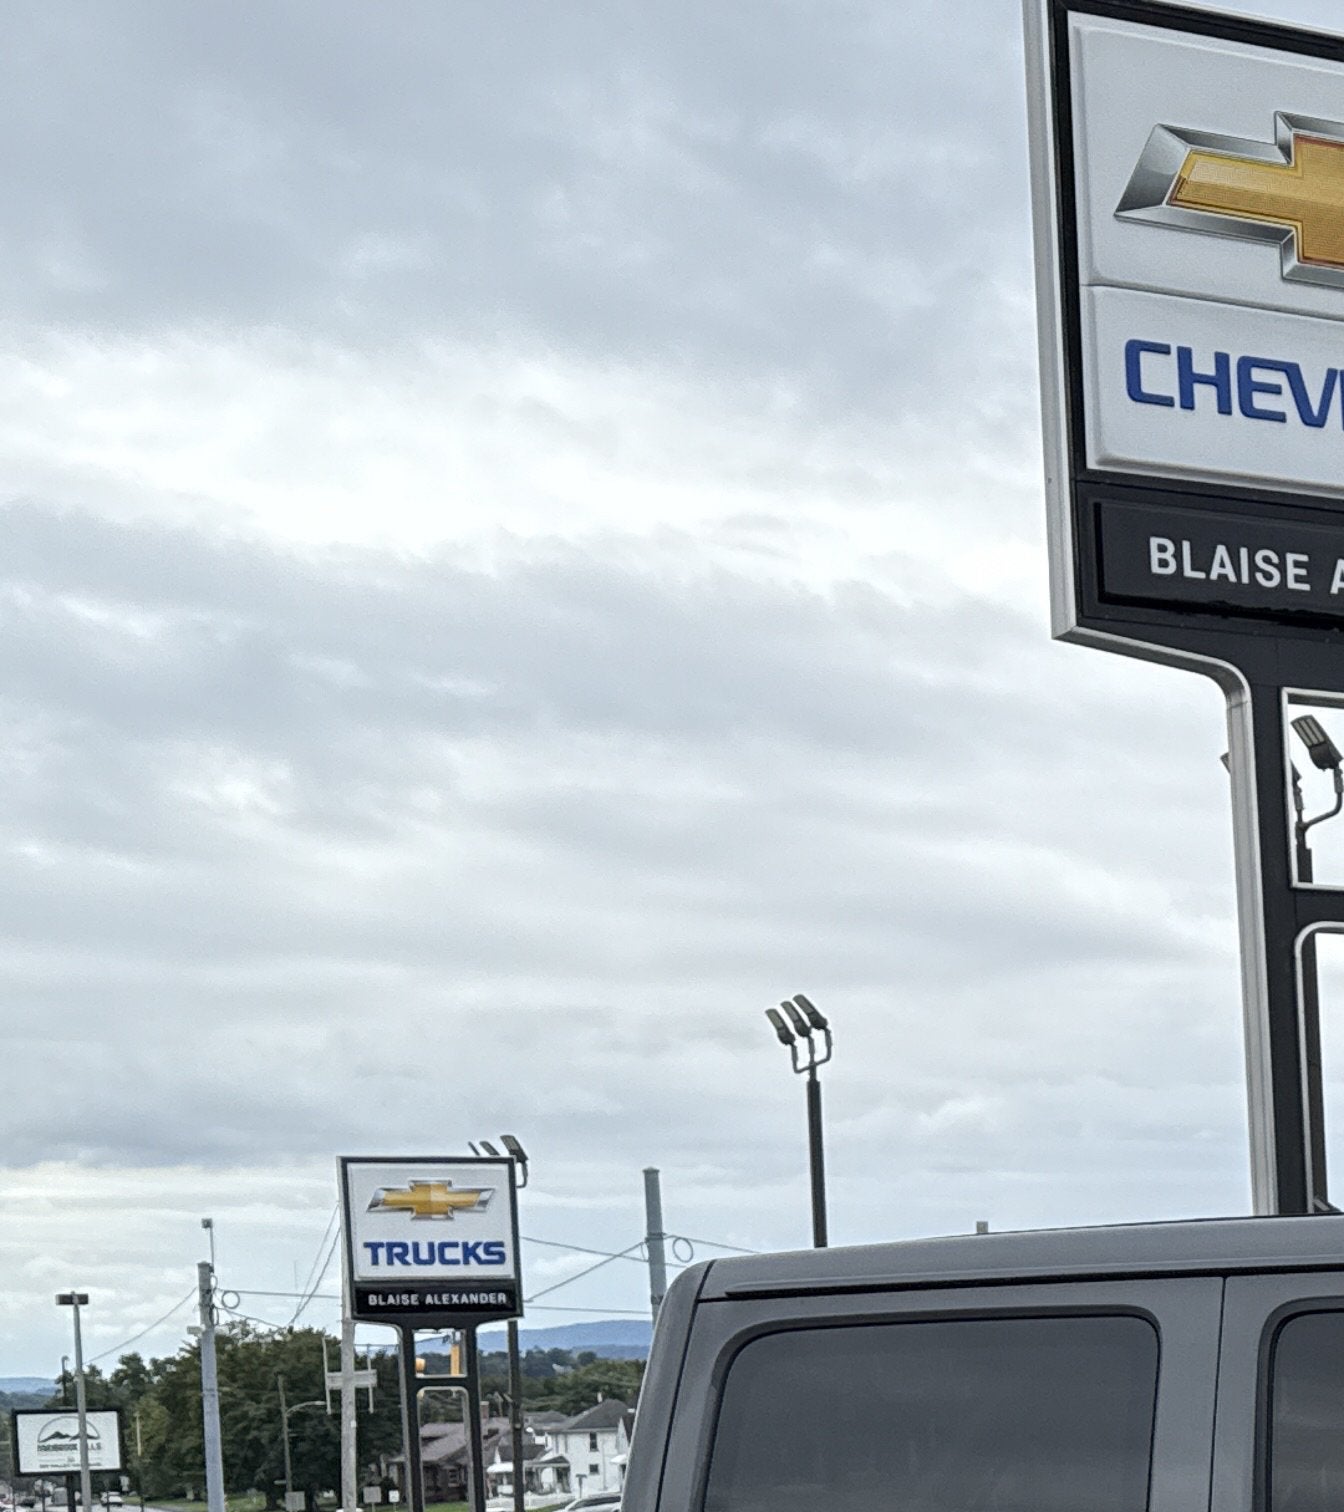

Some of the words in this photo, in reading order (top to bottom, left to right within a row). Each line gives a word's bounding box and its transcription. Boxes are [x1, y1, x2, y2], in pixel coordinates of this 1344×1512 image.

[1149, 536, 1312, 592] BLAISE
[363, 1241, 506, 1266] TRUCKS
[368, 1293, 419, 1306] BLAISE
[425, 1292, 507, 1305] ALEXANDER
